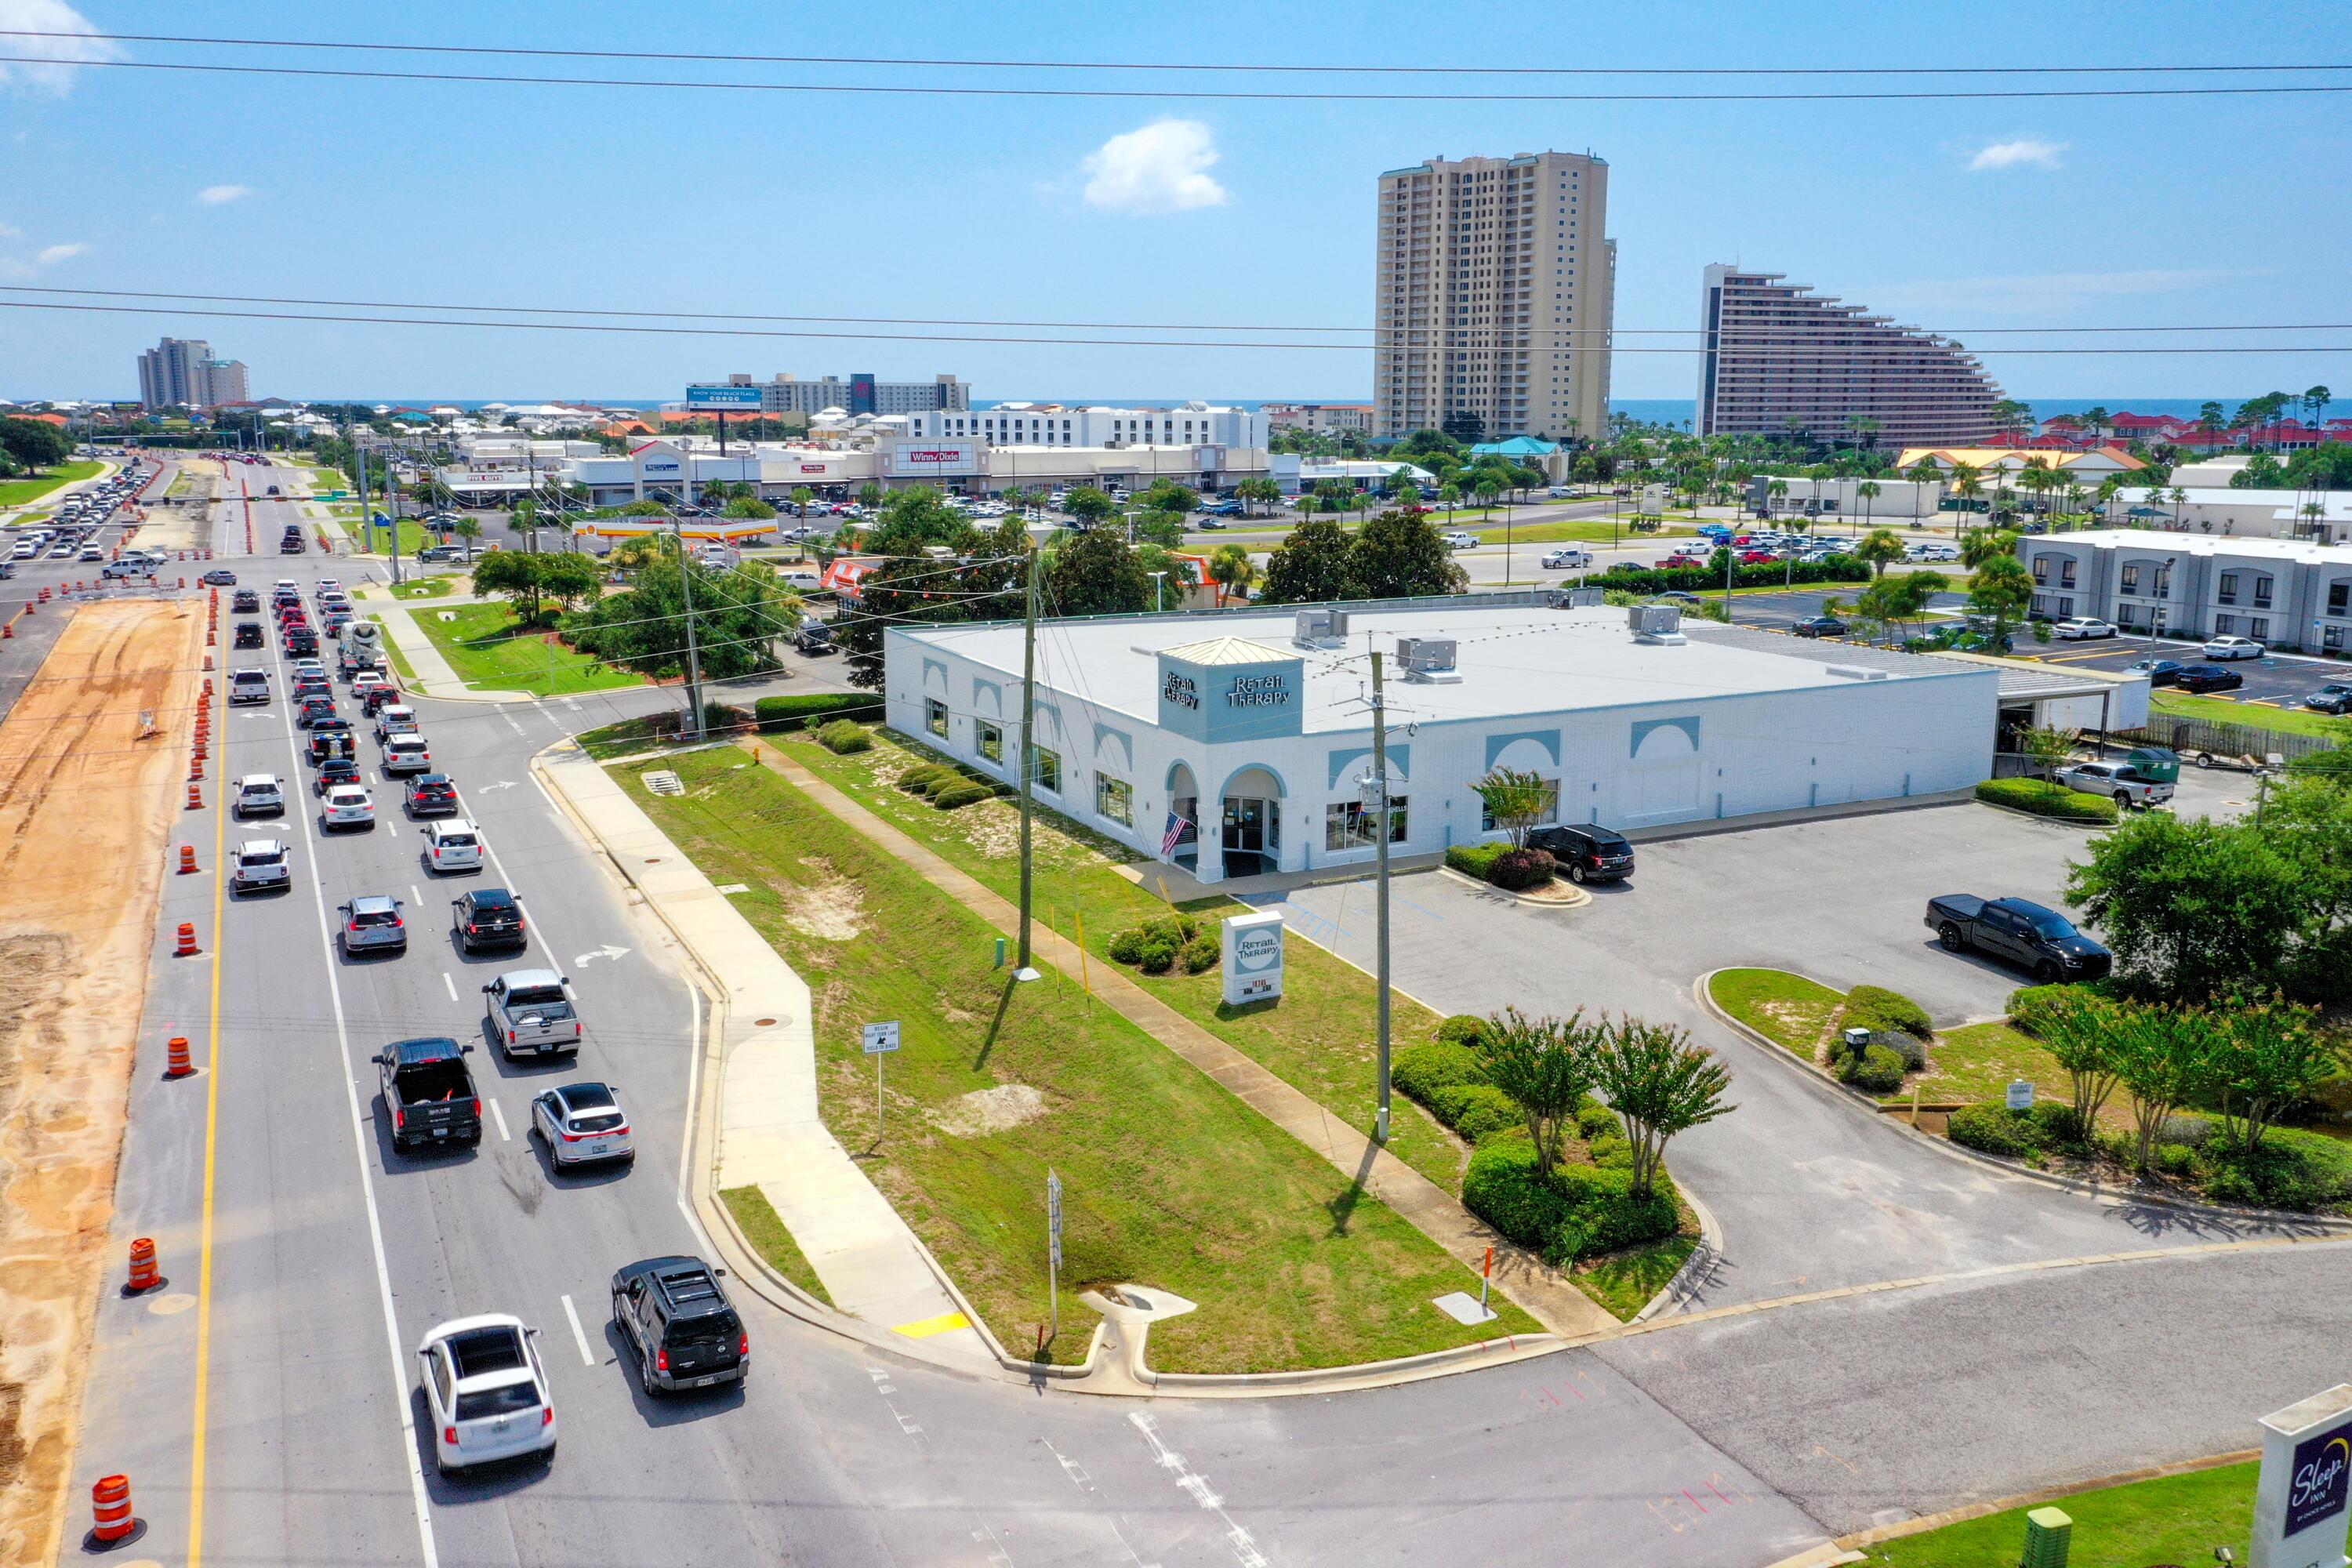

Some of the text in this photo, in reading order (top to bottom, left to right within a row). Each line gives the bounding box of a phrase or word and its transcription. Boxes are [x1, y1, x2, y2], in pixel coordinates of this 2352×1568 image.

[913, 452, 959, 462] Winn Dixie
[1389, 805, 1407, 815] SHELLS
[2292, 1457, 2343, 1507] Sleep
[2310, 1490, 2327, 1504] INN
